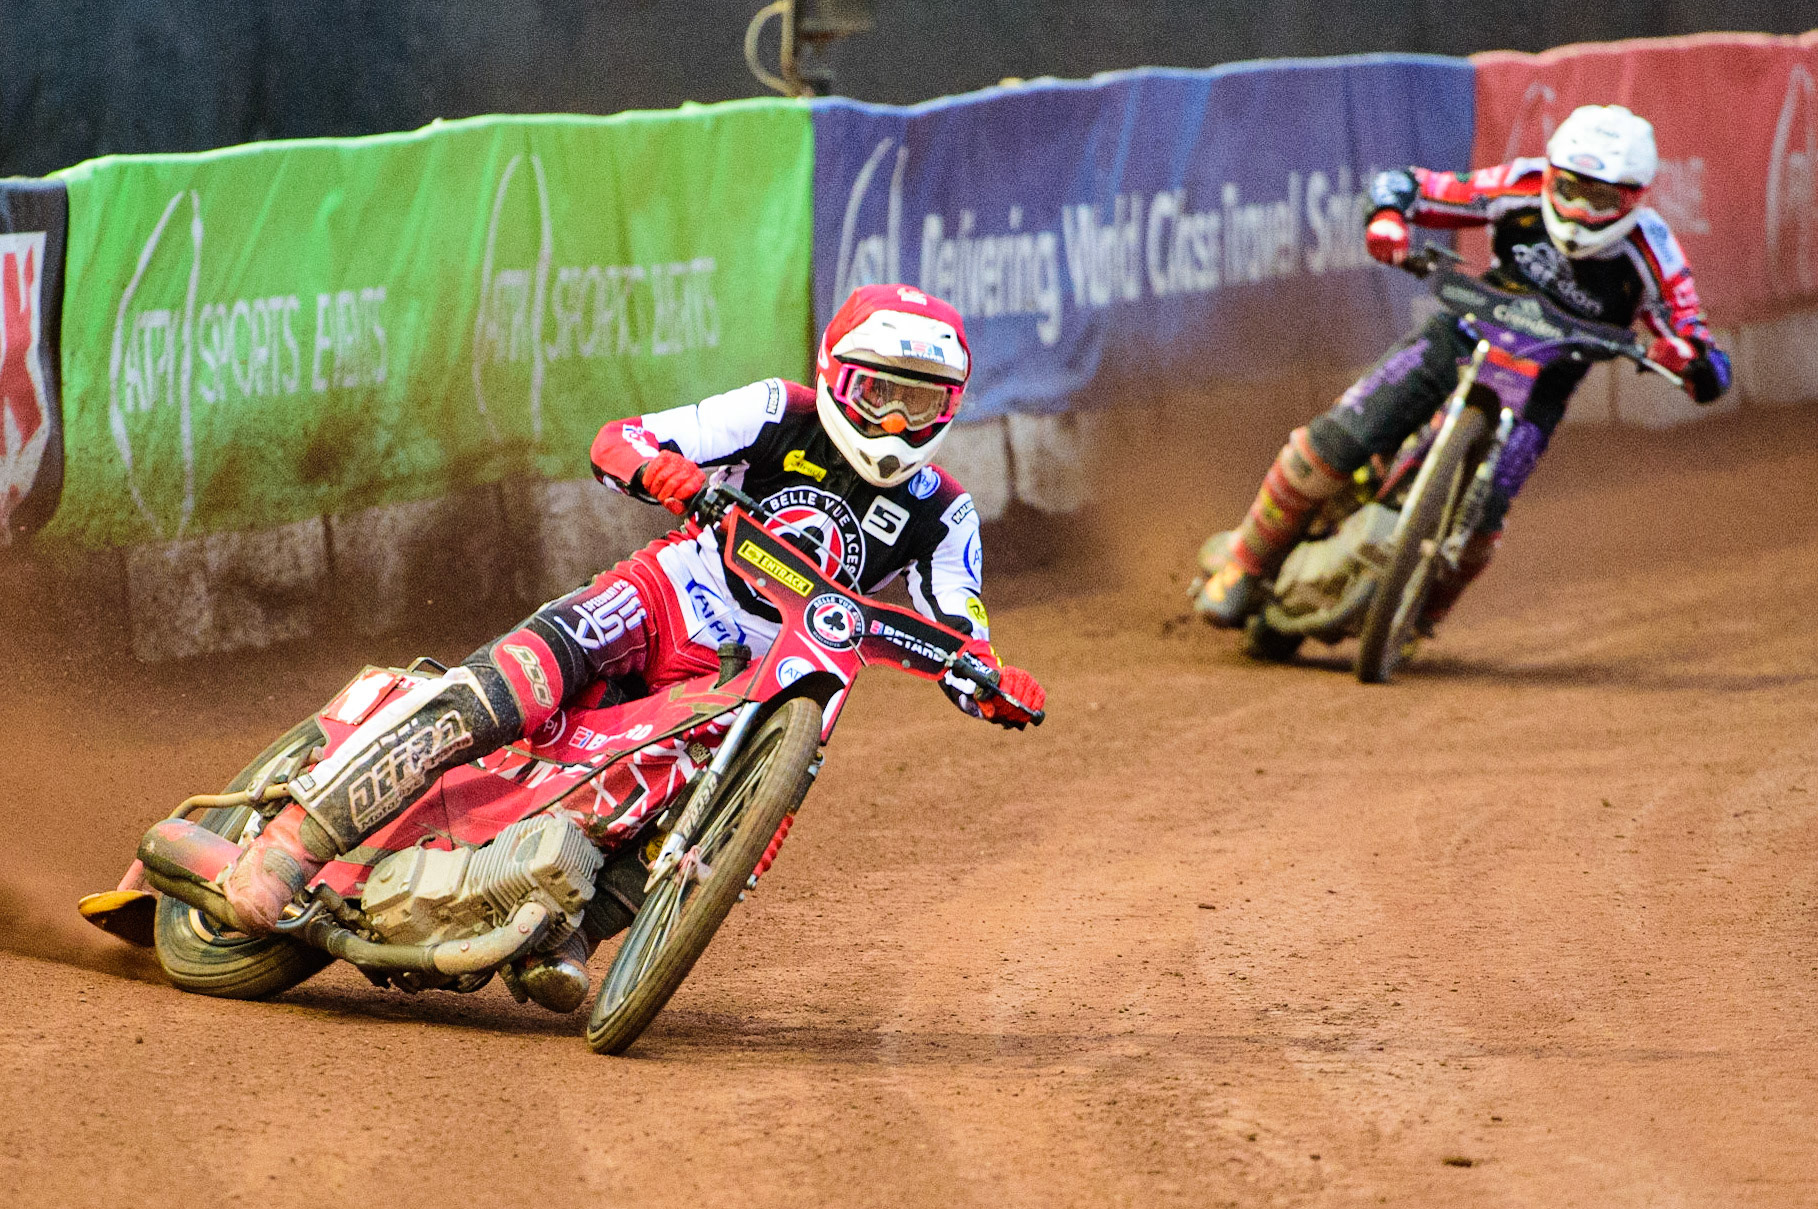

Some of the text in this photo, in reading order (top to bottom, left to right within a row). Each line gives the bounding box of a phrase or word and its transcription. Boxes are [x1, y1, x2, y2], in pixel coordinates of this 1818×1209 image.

[769, 491, 860, 575] BELLE VUE ACES
[760, 556, 807, 591] ENTRACK
